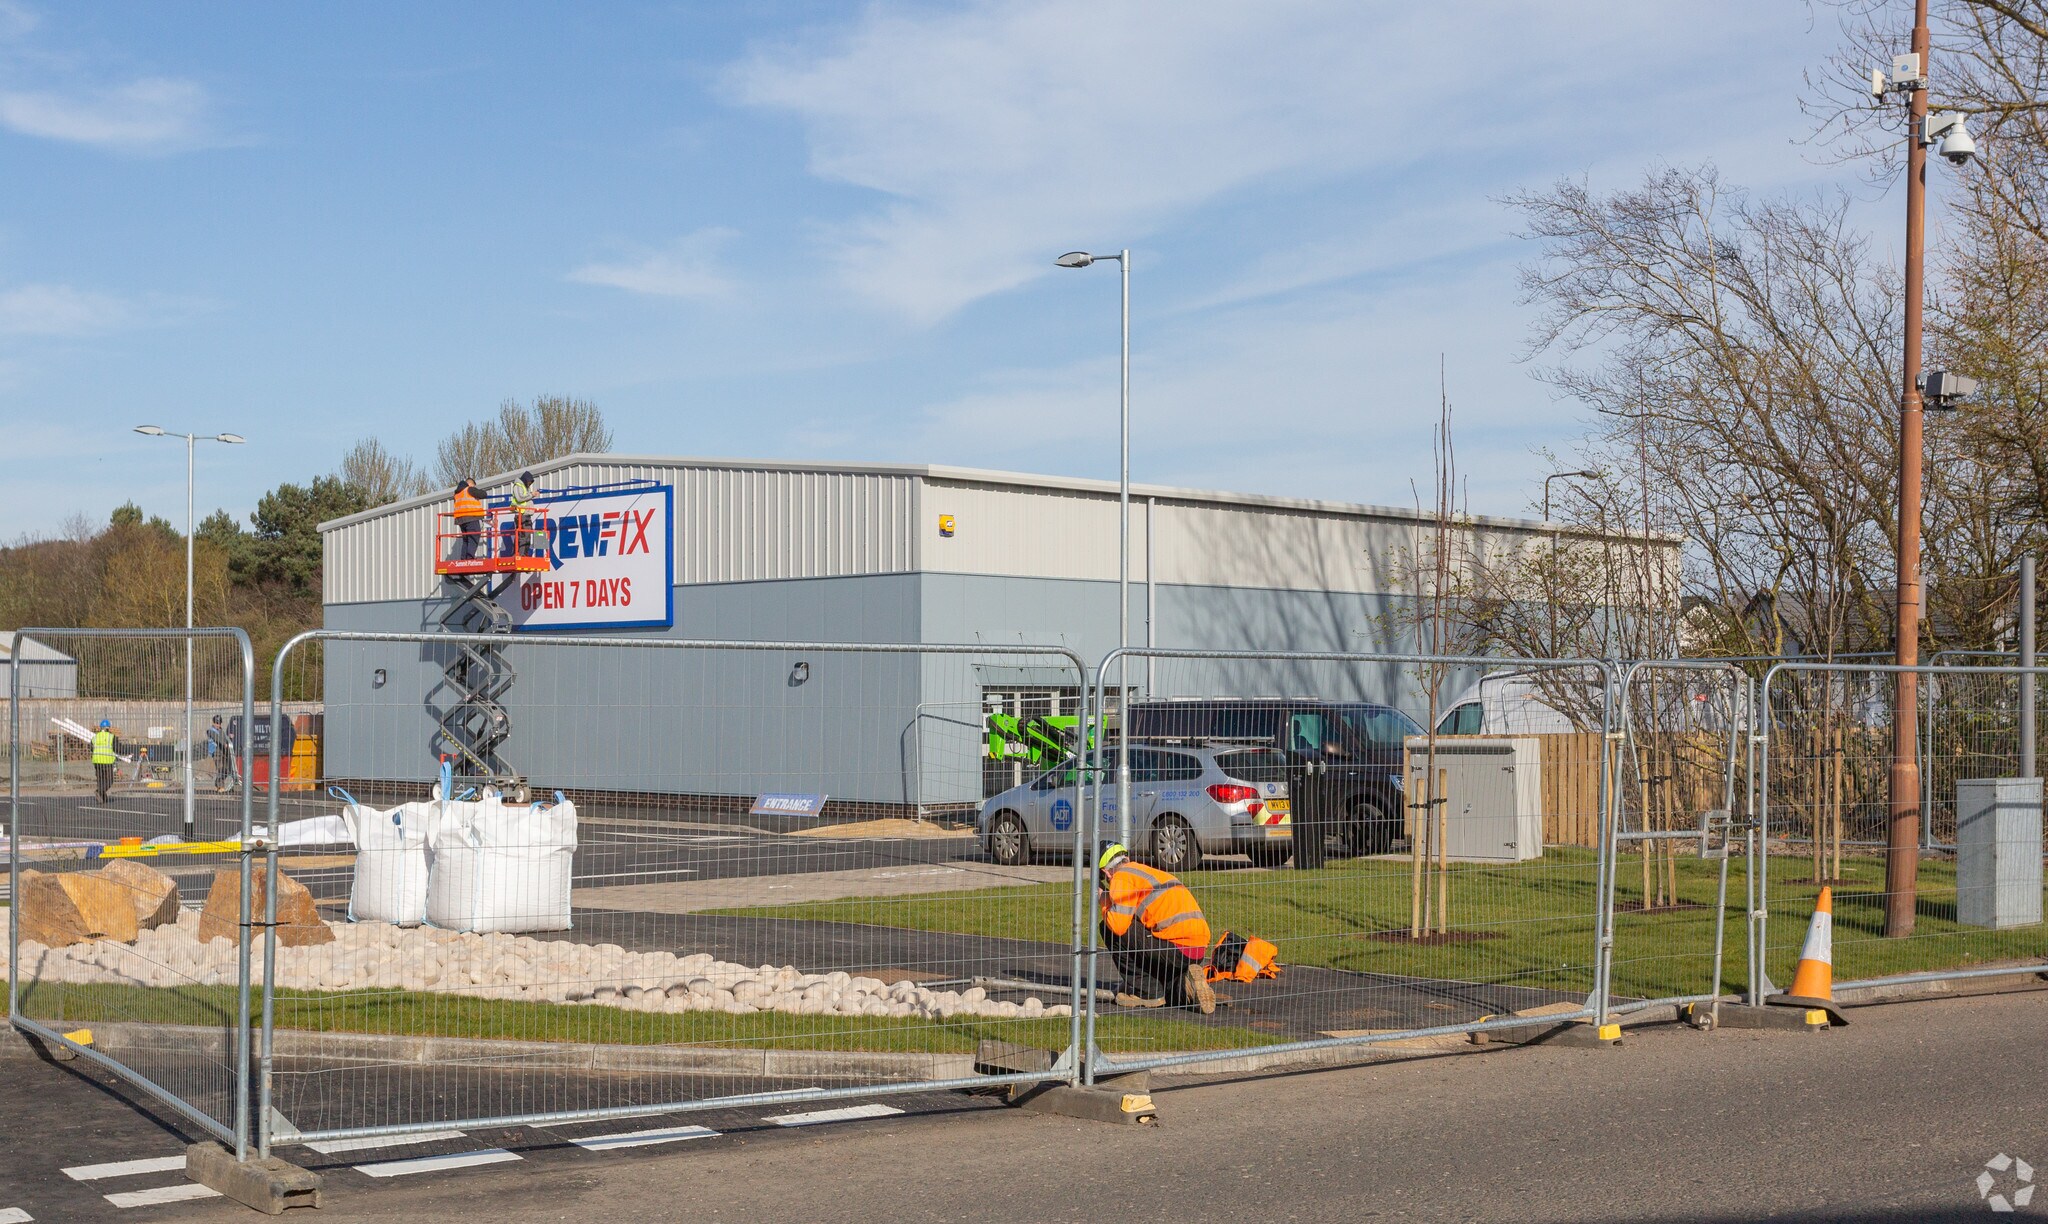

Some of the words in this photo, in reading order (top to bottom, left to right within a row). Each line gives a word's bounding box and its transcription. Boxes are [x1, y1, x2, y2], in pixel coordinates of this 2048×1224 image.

[500, 508, 656, 570] SREWFIX
[521, 581, 565, 611] OPEN
[570, 581, 580, 608] 7
[586, 577, 631, 608] DAYS
[764, 798, 813, 812] ENTRANCE
[1054, 809, 1070, 821] ADT
